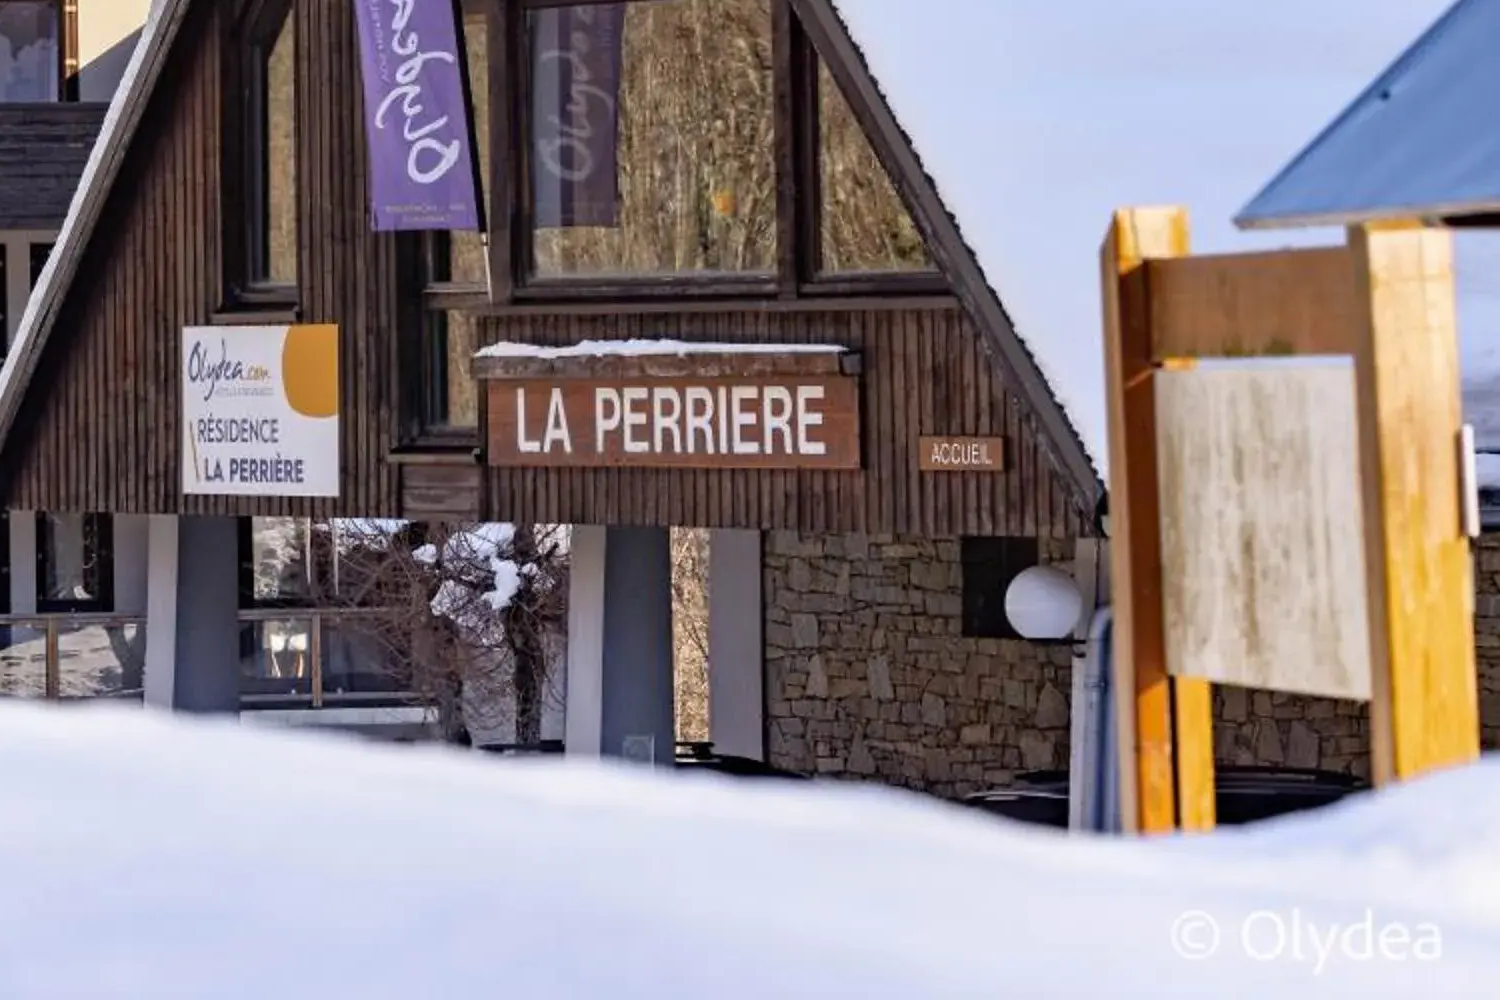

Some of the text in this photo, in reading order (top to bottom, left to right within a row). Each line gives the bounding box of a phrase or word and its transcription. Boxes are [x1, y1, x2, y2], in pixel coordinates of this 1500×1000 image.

[197, 413, 279, 444] RÉSIDENCE
[516, 385, 826, 456] LA PERRIERE
[204, 452, 304, 483] LA PERRIÈRE
[931, 442, 993, 466] ACCUEIL
